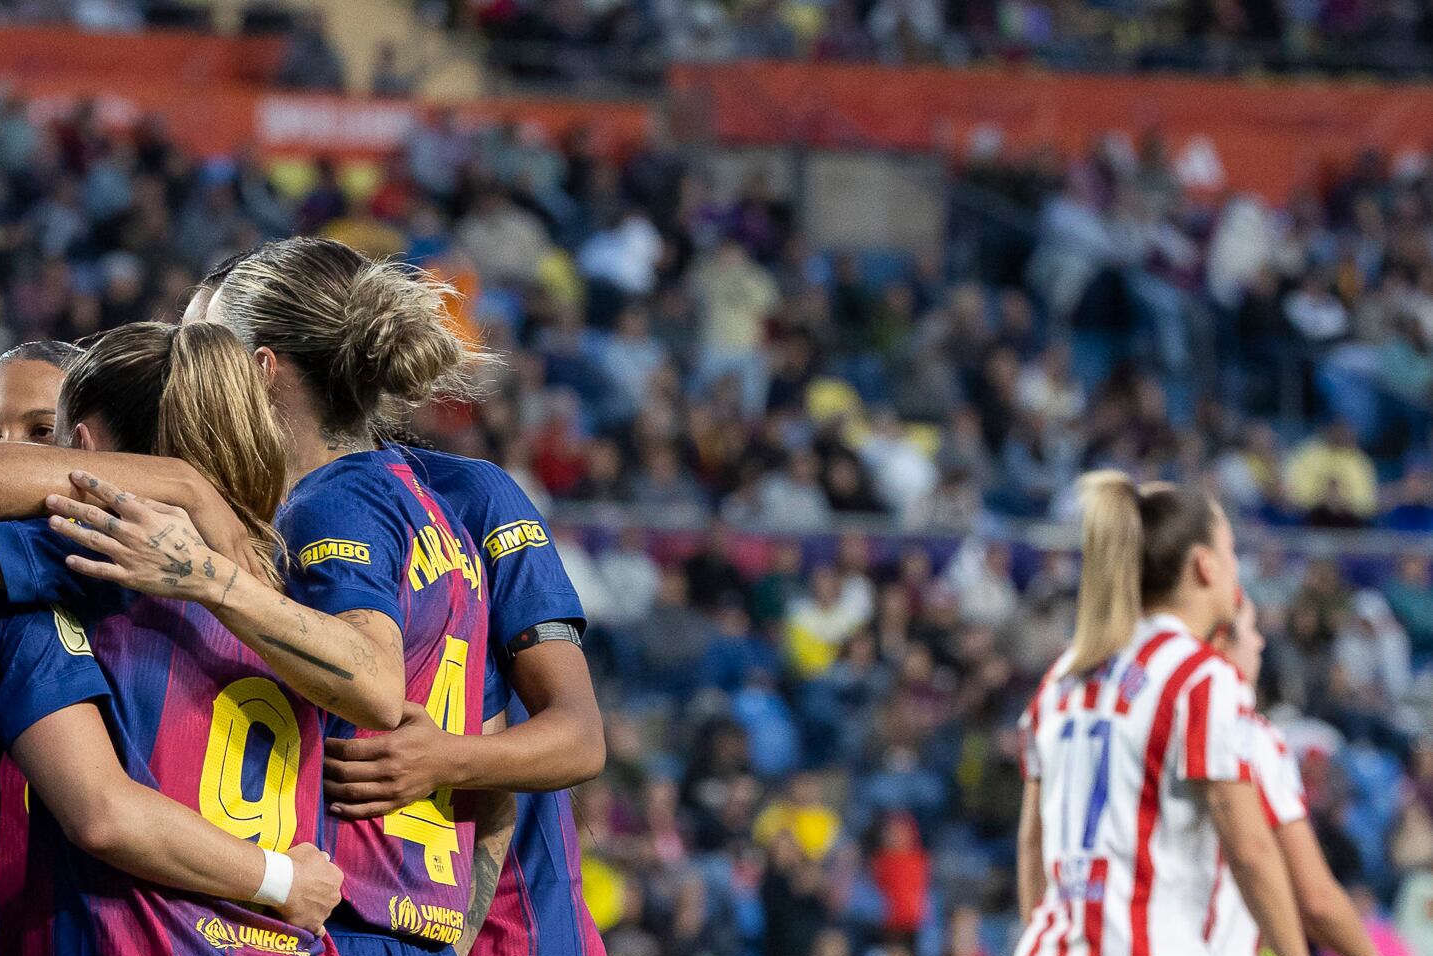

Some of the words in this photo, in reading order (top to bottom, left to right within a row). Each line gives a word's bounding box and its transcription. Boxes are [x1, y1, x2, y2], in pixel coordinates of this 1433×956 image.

[300, 543, 370, 567] BIMBO
[486, 524, 549, 558] BIMBO
[199, 676, 301, 856] 9
[383, 635, 469, 887] 4
[420, 904, 464, 929] UNHCR
[239, 925, 299, 951] UNHCR
